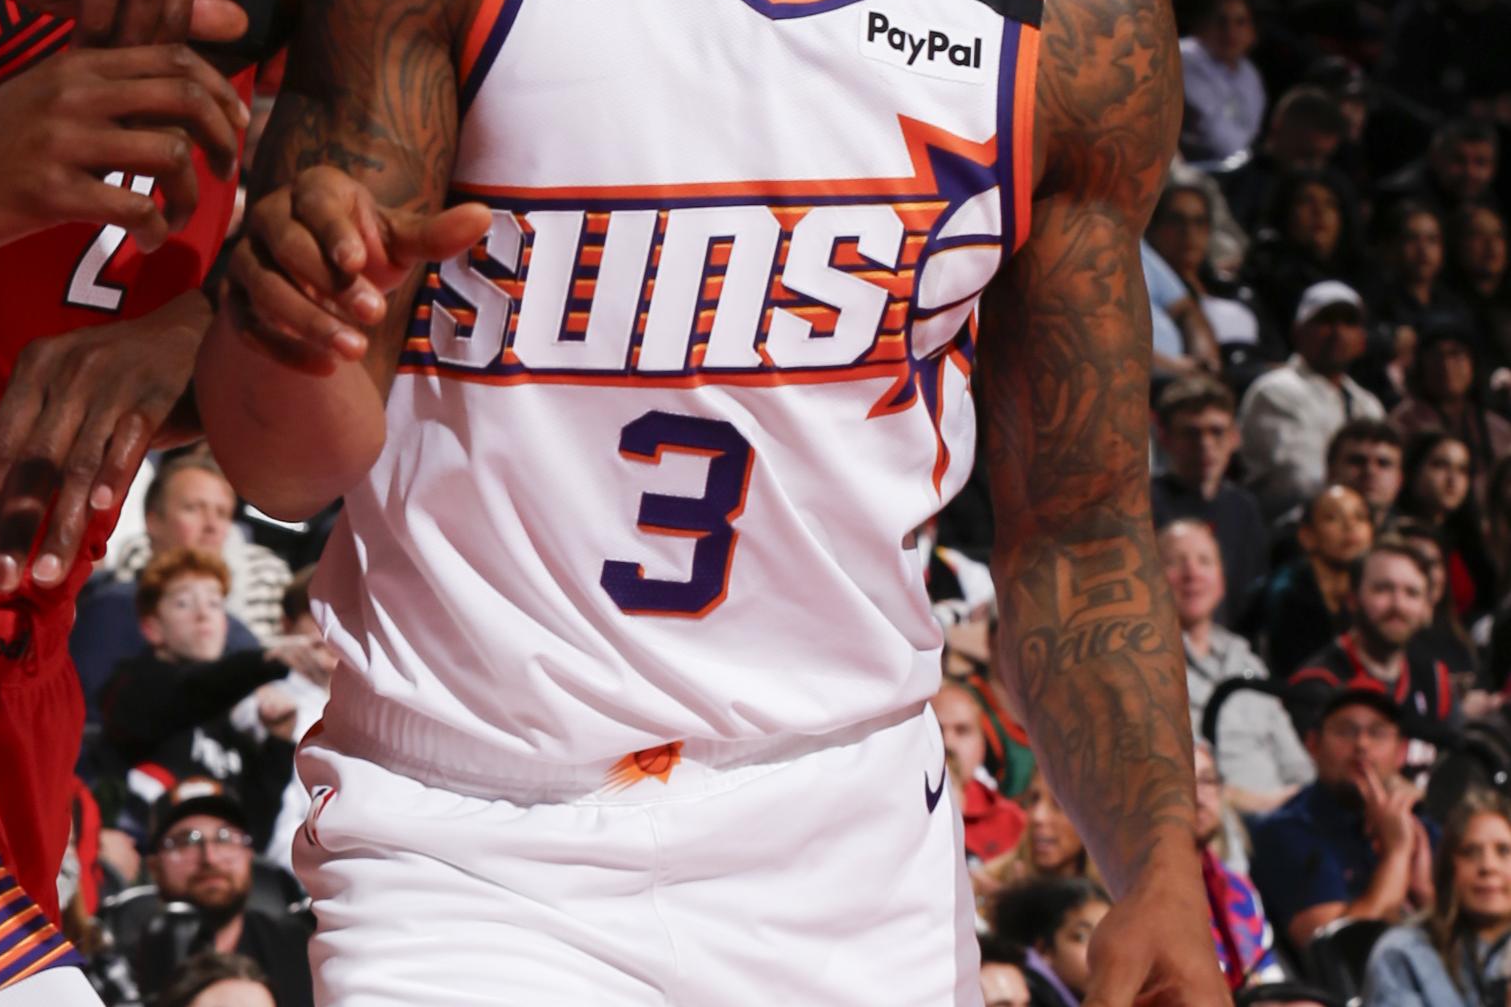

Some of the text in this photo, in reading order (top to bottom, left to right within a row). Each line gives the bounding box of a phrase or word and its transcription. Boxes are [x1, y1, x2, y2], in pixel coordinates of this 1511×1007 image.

[867, 11, 982, 69] PayPal
[430, 204, 905, 371] SUNS
[599, 409, 757, 620] 3
